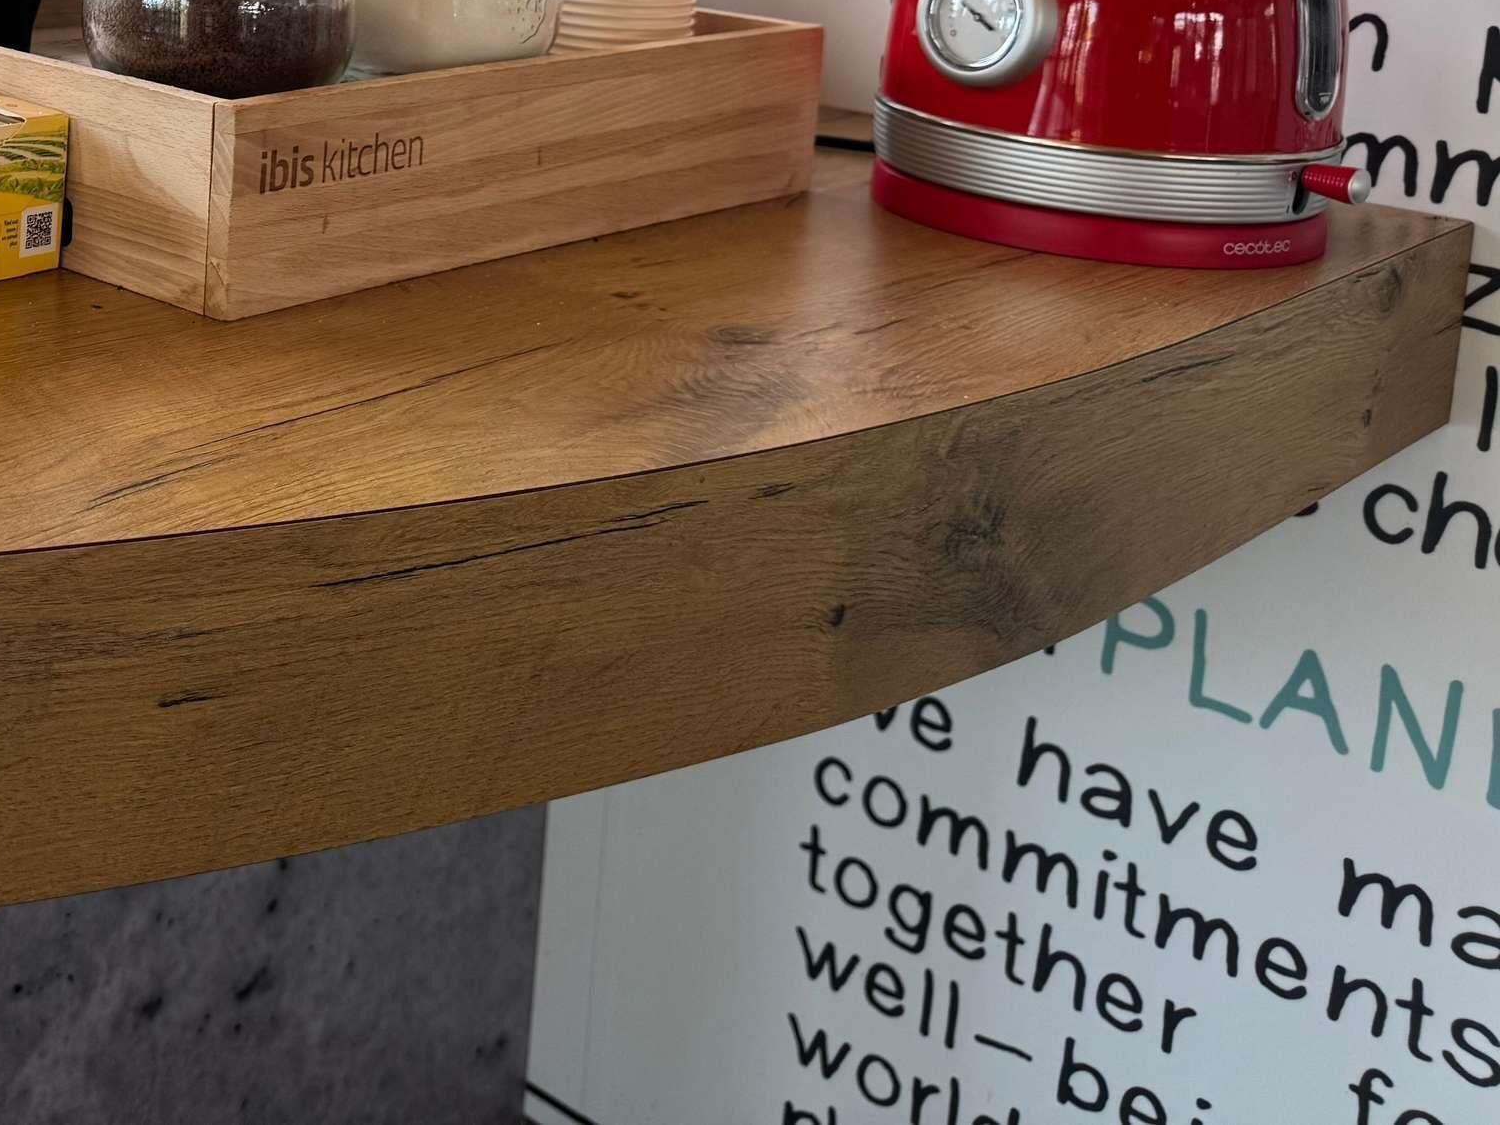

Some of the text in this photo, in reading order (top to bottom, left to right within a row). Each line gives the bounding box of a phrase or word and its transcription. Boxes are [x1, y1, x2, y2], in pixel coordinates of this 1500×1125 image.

[259, 132, 424, 194] ibis kitchen
[1223, 239, 1292, 255] cecotec
[1018, 716, 1258, 871] have
[1101, 594, 1500, 810] PLAN
[800, 824, 1197, 1054] together
[813, 756, 1500, 1087] commitments
